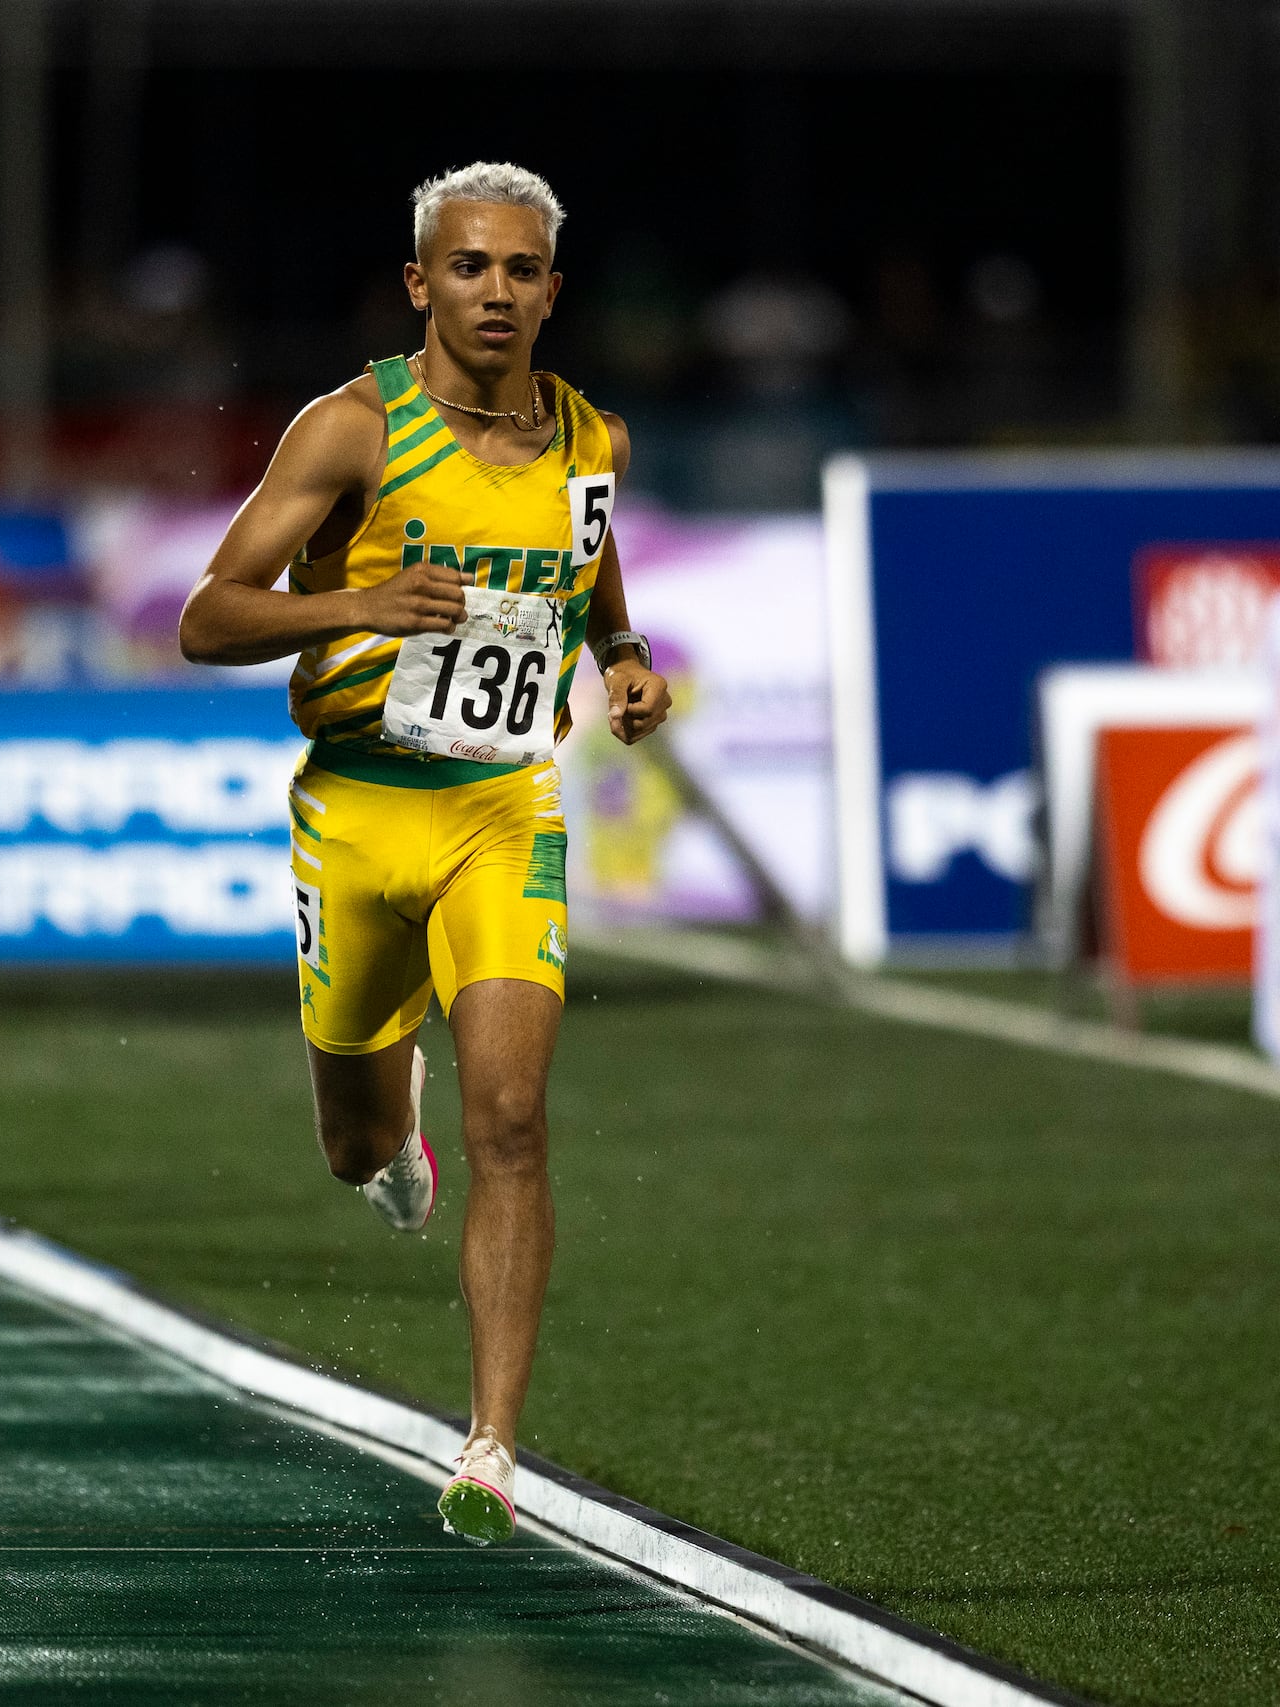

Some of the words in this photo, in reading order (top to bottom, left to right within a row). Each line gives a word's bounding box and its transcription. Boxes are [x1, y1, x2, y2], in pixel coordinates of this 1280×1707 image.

[581, 484, 610, 557] 5
[428, 637, 546, 736] 136
[295, 886, 312, 955] 5
